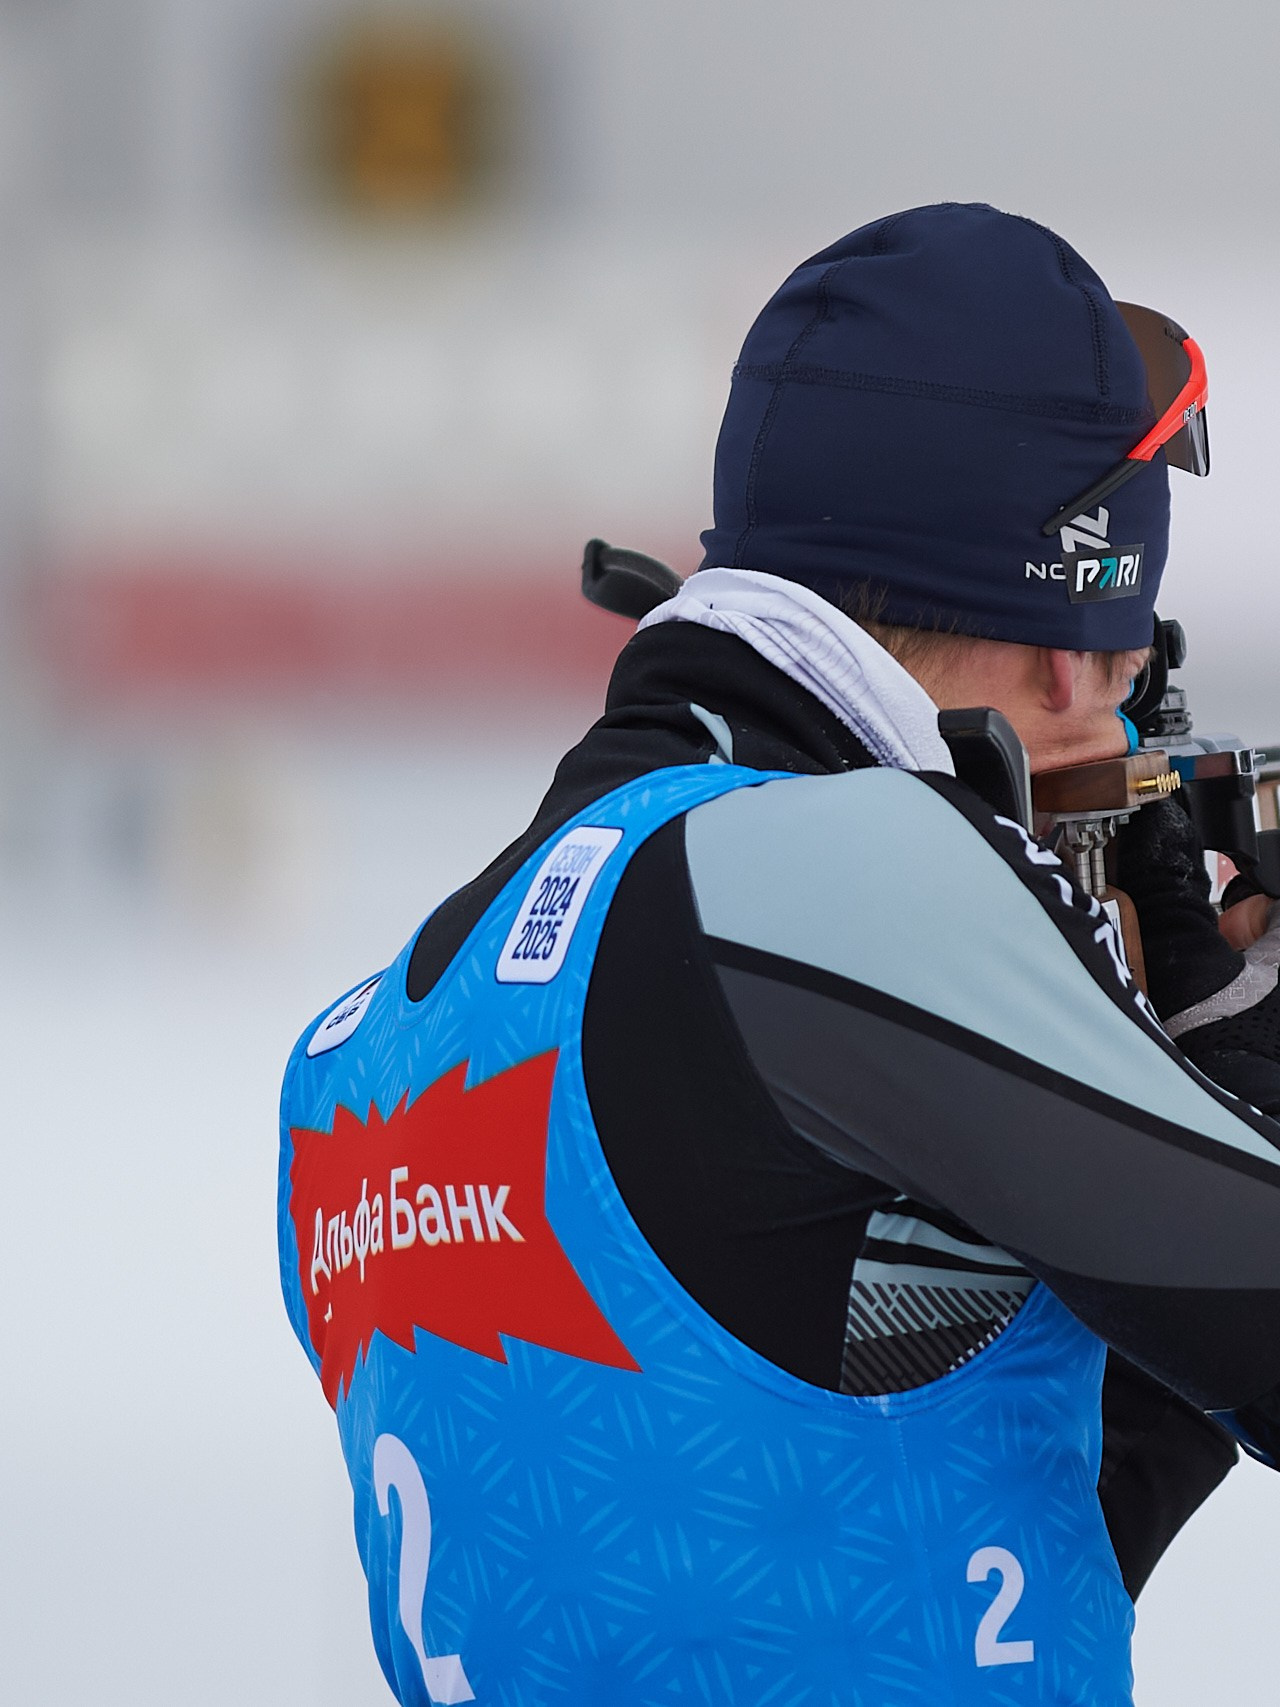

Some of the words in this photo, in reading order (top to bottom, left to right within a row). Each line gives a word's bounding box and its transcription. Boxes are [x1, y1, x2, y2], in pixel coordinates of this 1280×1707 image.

[1075, 553, 1140, 593] PARI
[550, 843, 601, 874] СЕЗОН
[529, 875, 581, 916] 2024
[511, 919, 564, 960] 2025
[310, 1177, 385, 1296] Альфа
[389, 1165, 527, 1250] Банк
[372, 1432, 476, 1706] 2
[965, 1545, 1035, 1668] 2
